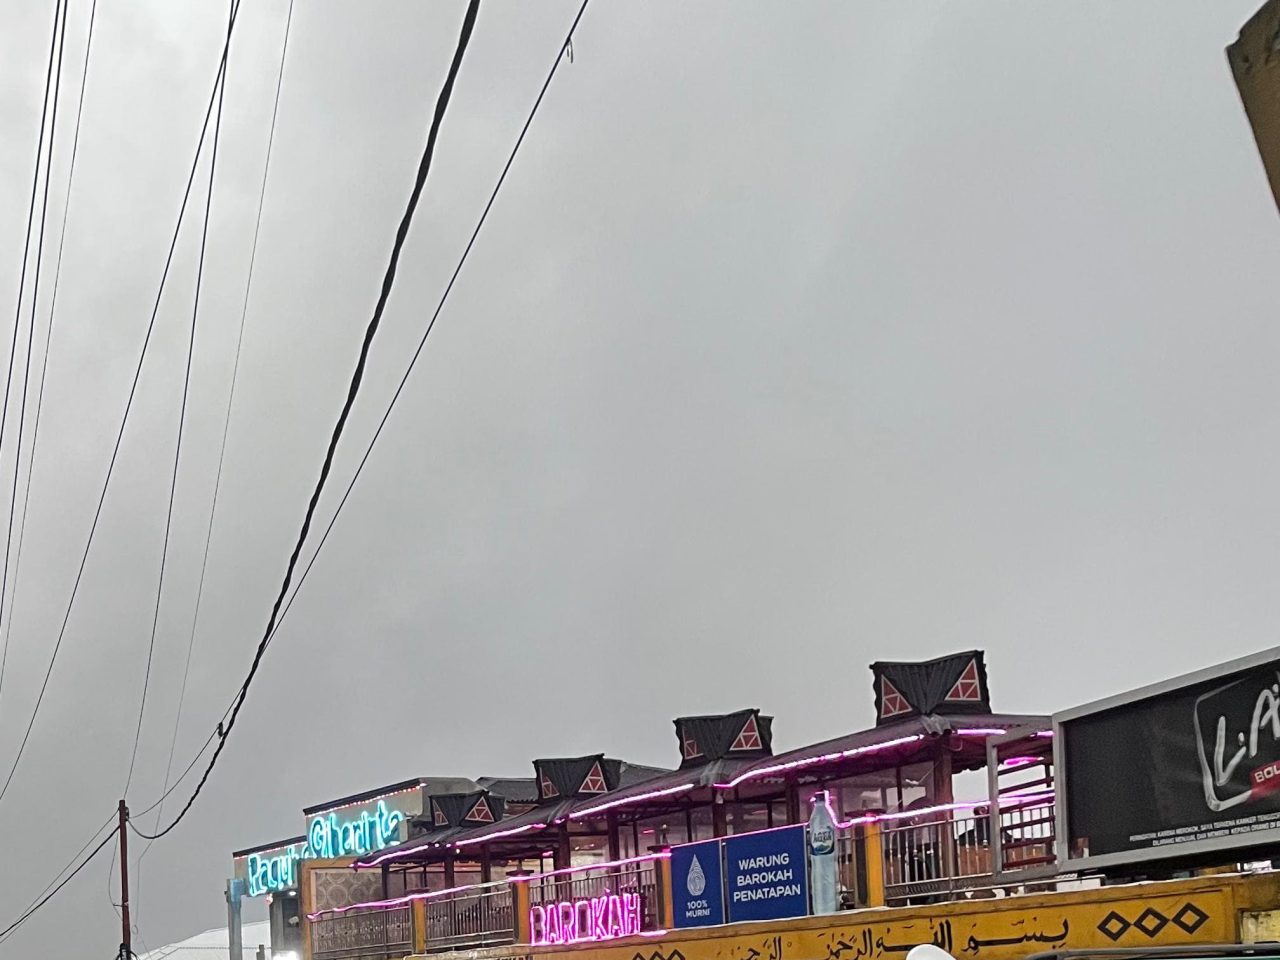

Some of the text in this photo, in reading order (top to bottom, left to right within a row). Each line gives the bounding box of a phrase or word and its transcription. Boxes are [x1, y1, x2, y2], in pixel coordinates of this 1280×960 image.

[738, 853, 790, 871] WARUNG
[736, 869, 793, 887] BAROKAH
[733, 884, 801, 902] PENATAPAN
[686, 908, 710, 918] MURNI
[687, 899, 708, 909] 100%
[530, 893, 640, 946] BAROKAH
